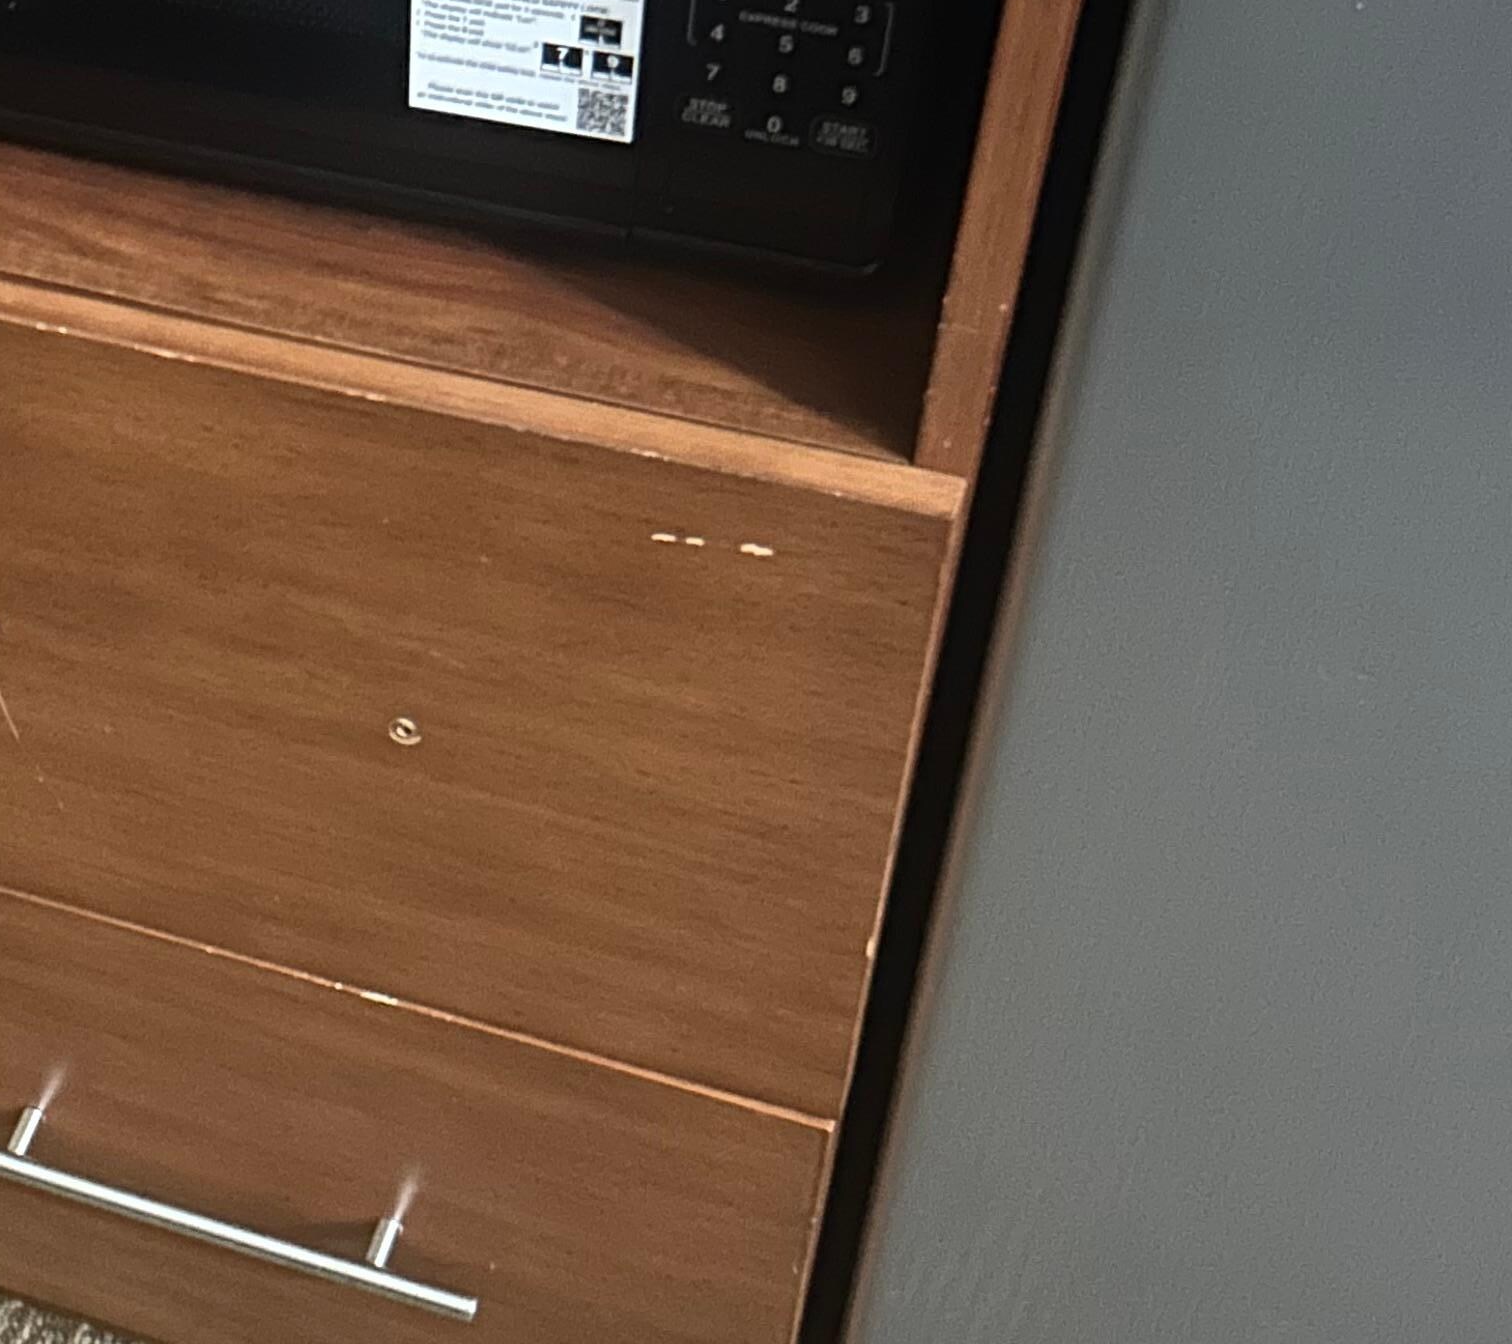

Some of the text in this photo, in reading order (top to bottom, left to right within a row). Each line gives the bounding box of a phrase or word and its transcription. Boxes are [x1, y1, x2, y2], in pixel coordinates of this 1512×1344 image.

[854, 5, 870, 24] 3
[710, 24, 725, 42] 4
[779, 35, 794, 53] 5
[848, 47, 864, 66] 6
[706, 63, 721, 80] 7
[773, 75, 788, 93] 8
[842, 87, 857, 105] 9
[767, 116, 782, 133] 0
